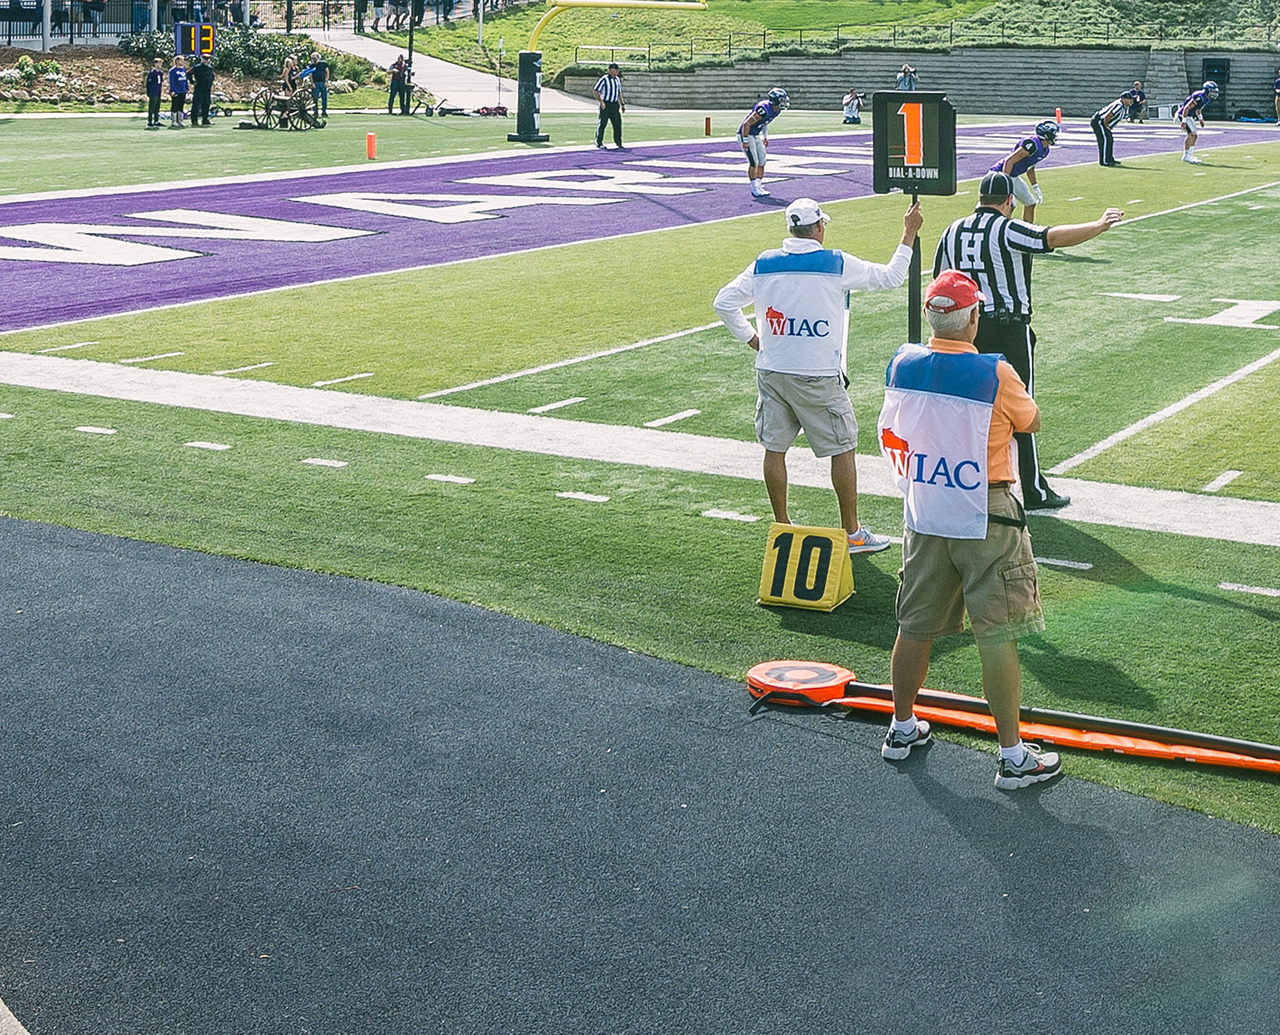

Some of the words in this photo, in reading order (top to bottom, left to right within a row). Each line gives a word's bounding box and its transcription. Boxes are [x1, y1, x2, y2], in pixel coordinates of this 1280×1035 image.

[190, 25, 213, 53] 13
[896, 102, 924, 166] 1
[960, 232, 985, 270] H
[766, 315, 830, 337] WIAC
[883, 444, 982, 491] WIAC
[770, 532, 834, 601] 10
